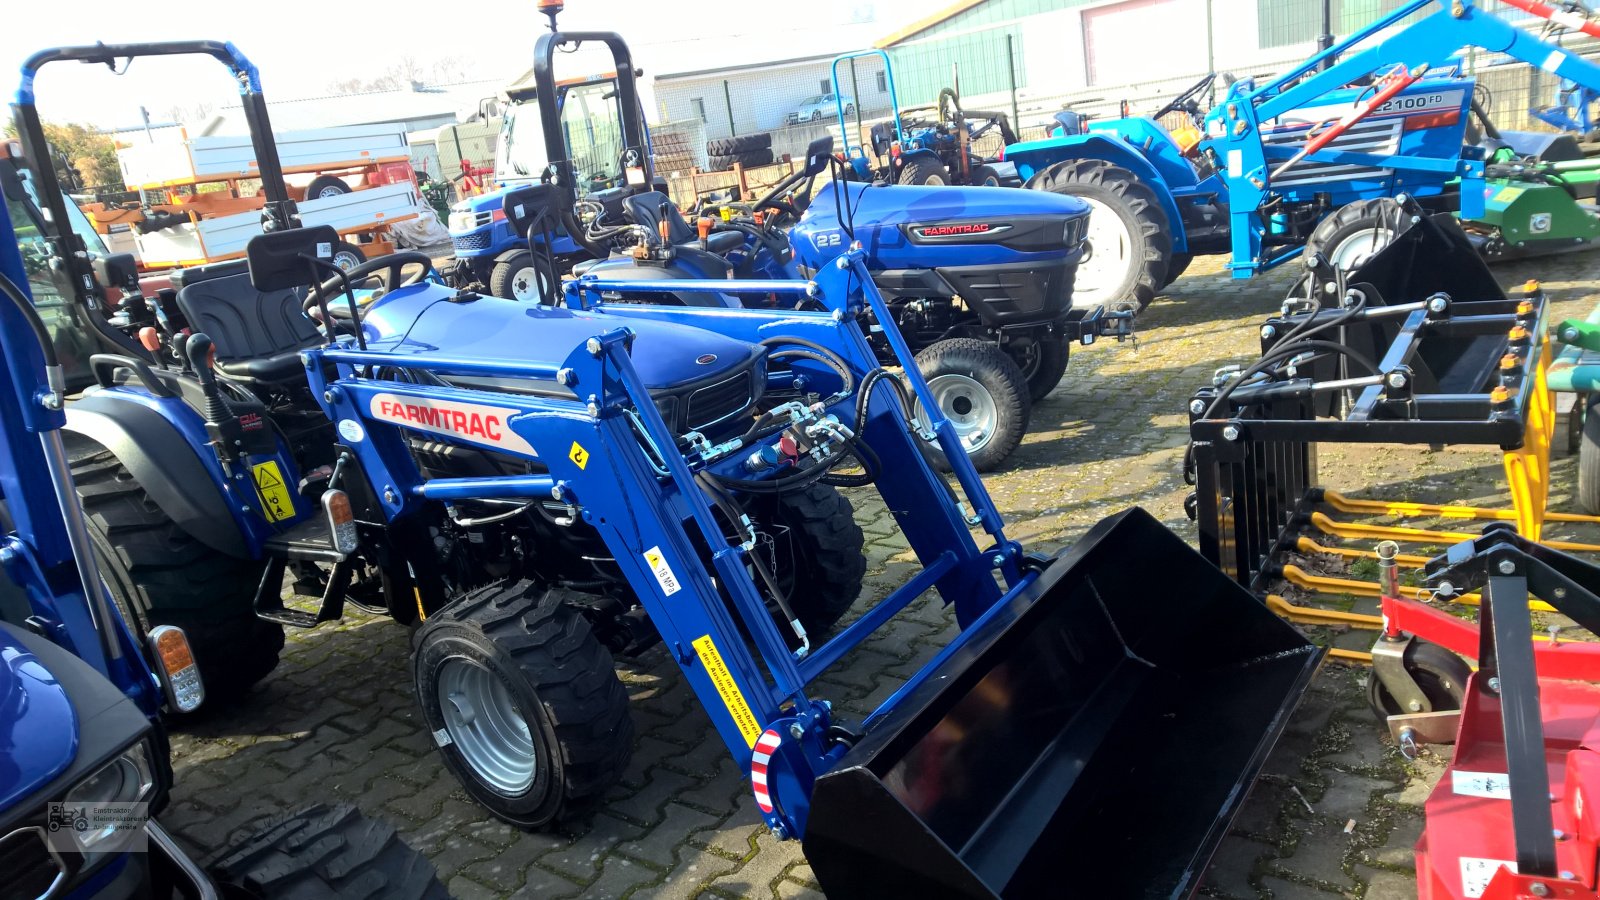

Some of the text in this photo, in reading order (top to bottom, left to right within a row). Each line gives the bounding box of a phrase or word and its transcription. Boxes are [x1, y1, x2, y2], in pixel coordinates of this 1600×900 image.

[816, 234, 842, 247] 22
[923, 224, 990, 236] FARMTRAC
[380, 400, 502, 442] FARMTRAC
[657, 567, 676, 594] 18 MPa
[701, 651, 751, 737] des Auslegers verboten
[703, 638, 727, 678] Aufenthalt
[731, 689, 760, 738] Arbeitsbereic
